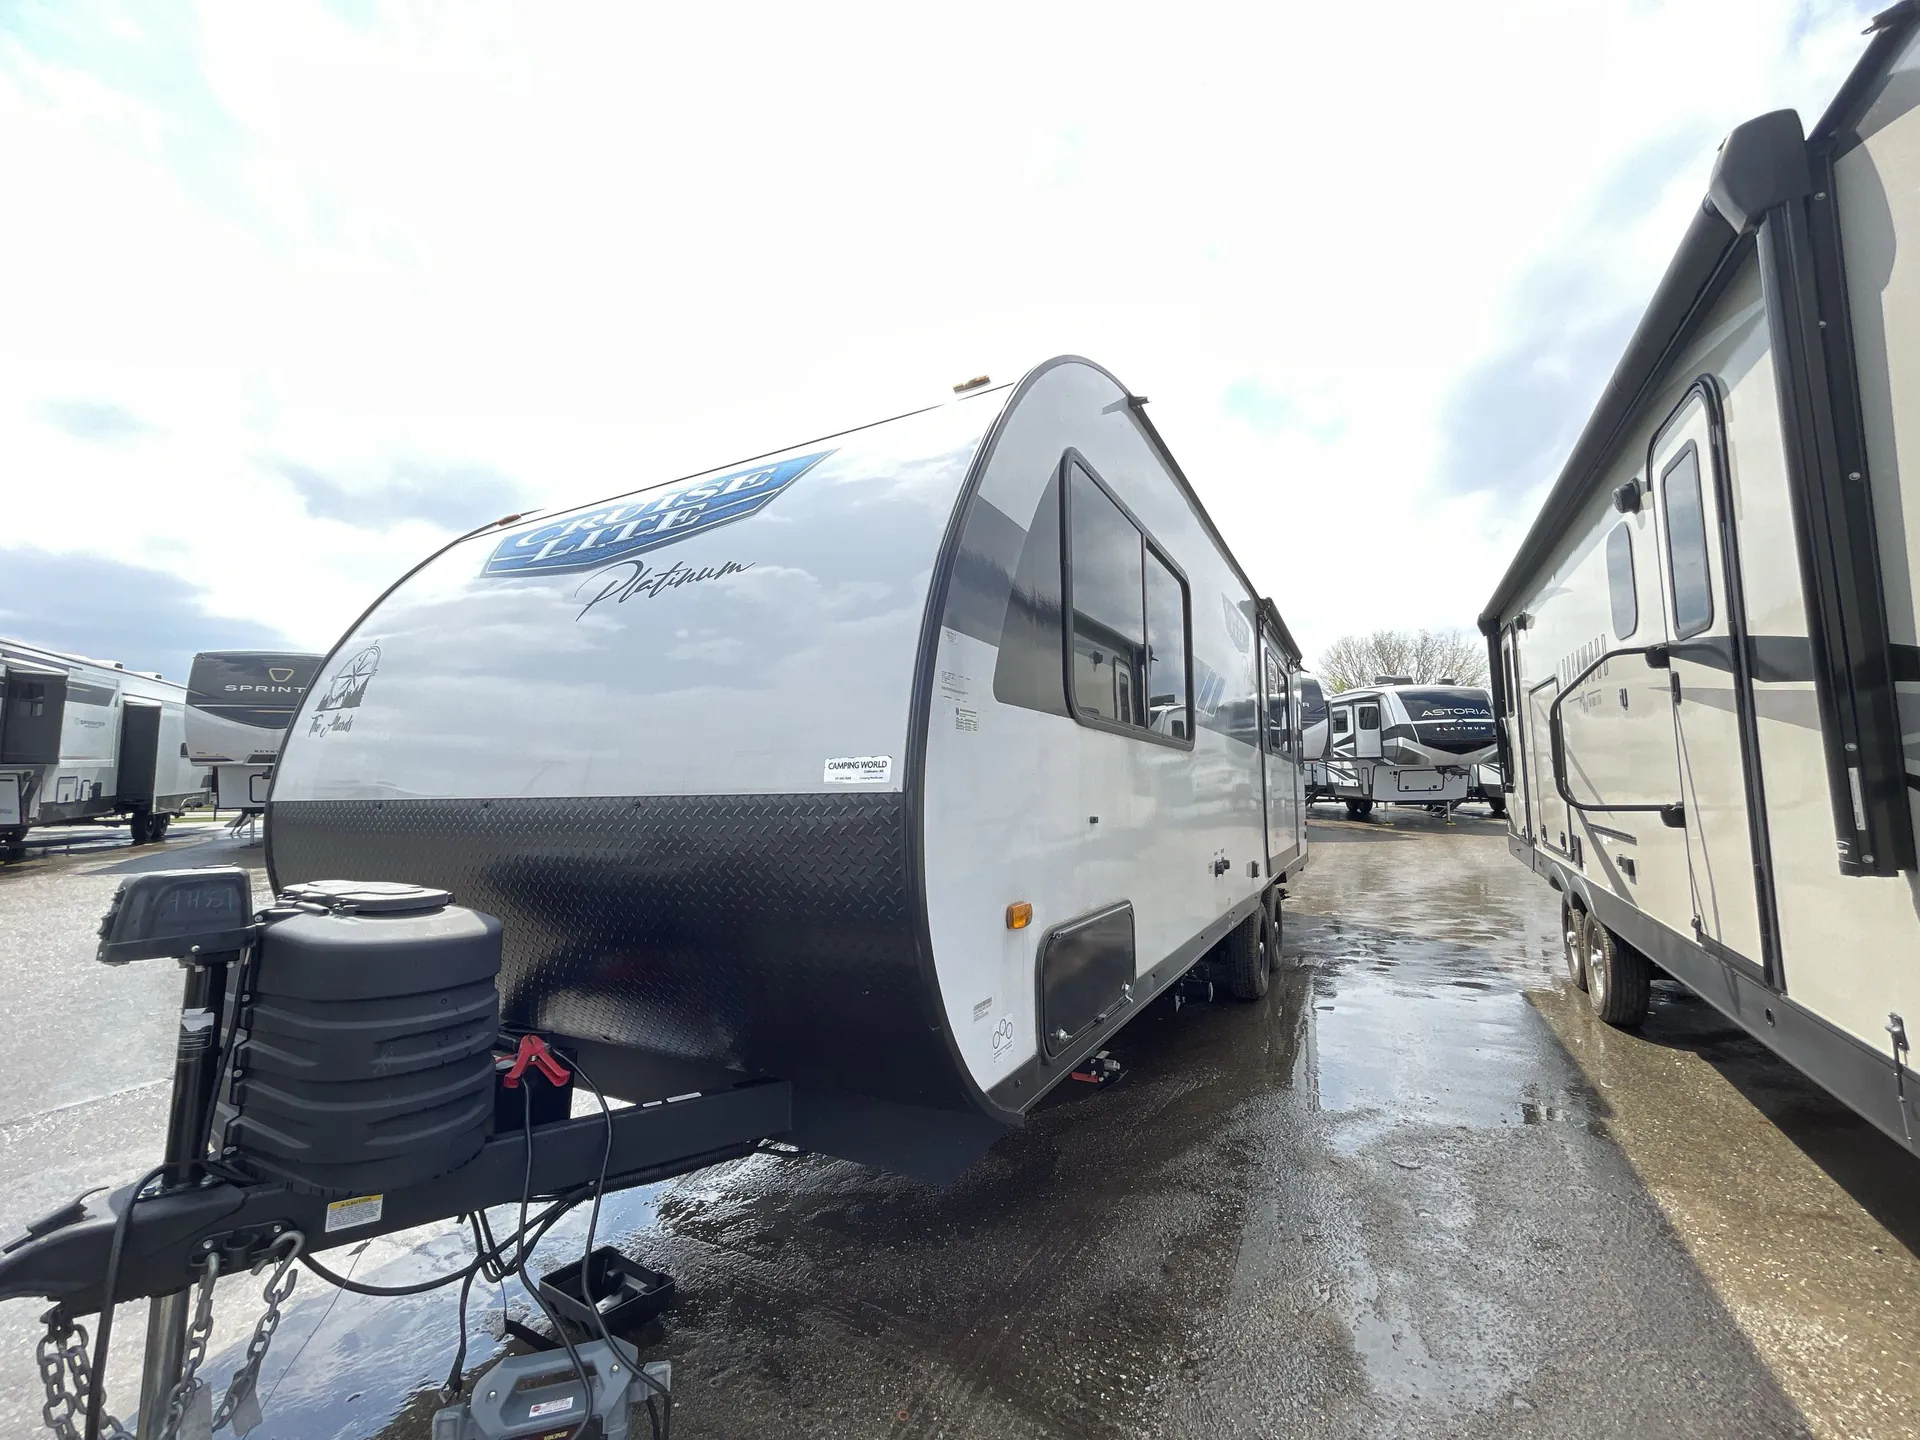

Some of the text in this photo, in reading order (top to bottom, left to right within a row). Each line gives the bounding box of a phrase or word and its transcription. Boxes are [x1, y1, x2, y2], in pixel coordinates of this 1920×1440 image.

[516, 467, 778, 548] CRUISE
[525, 503, 708, 564] LITE
[574, 559, 757, 623] Platinum
[224, 684, 306, 694] SPRINT
[1421, 707, 1491, 717] ASTORIA
[828, 760, 888, 770] CAMPING WORLD
